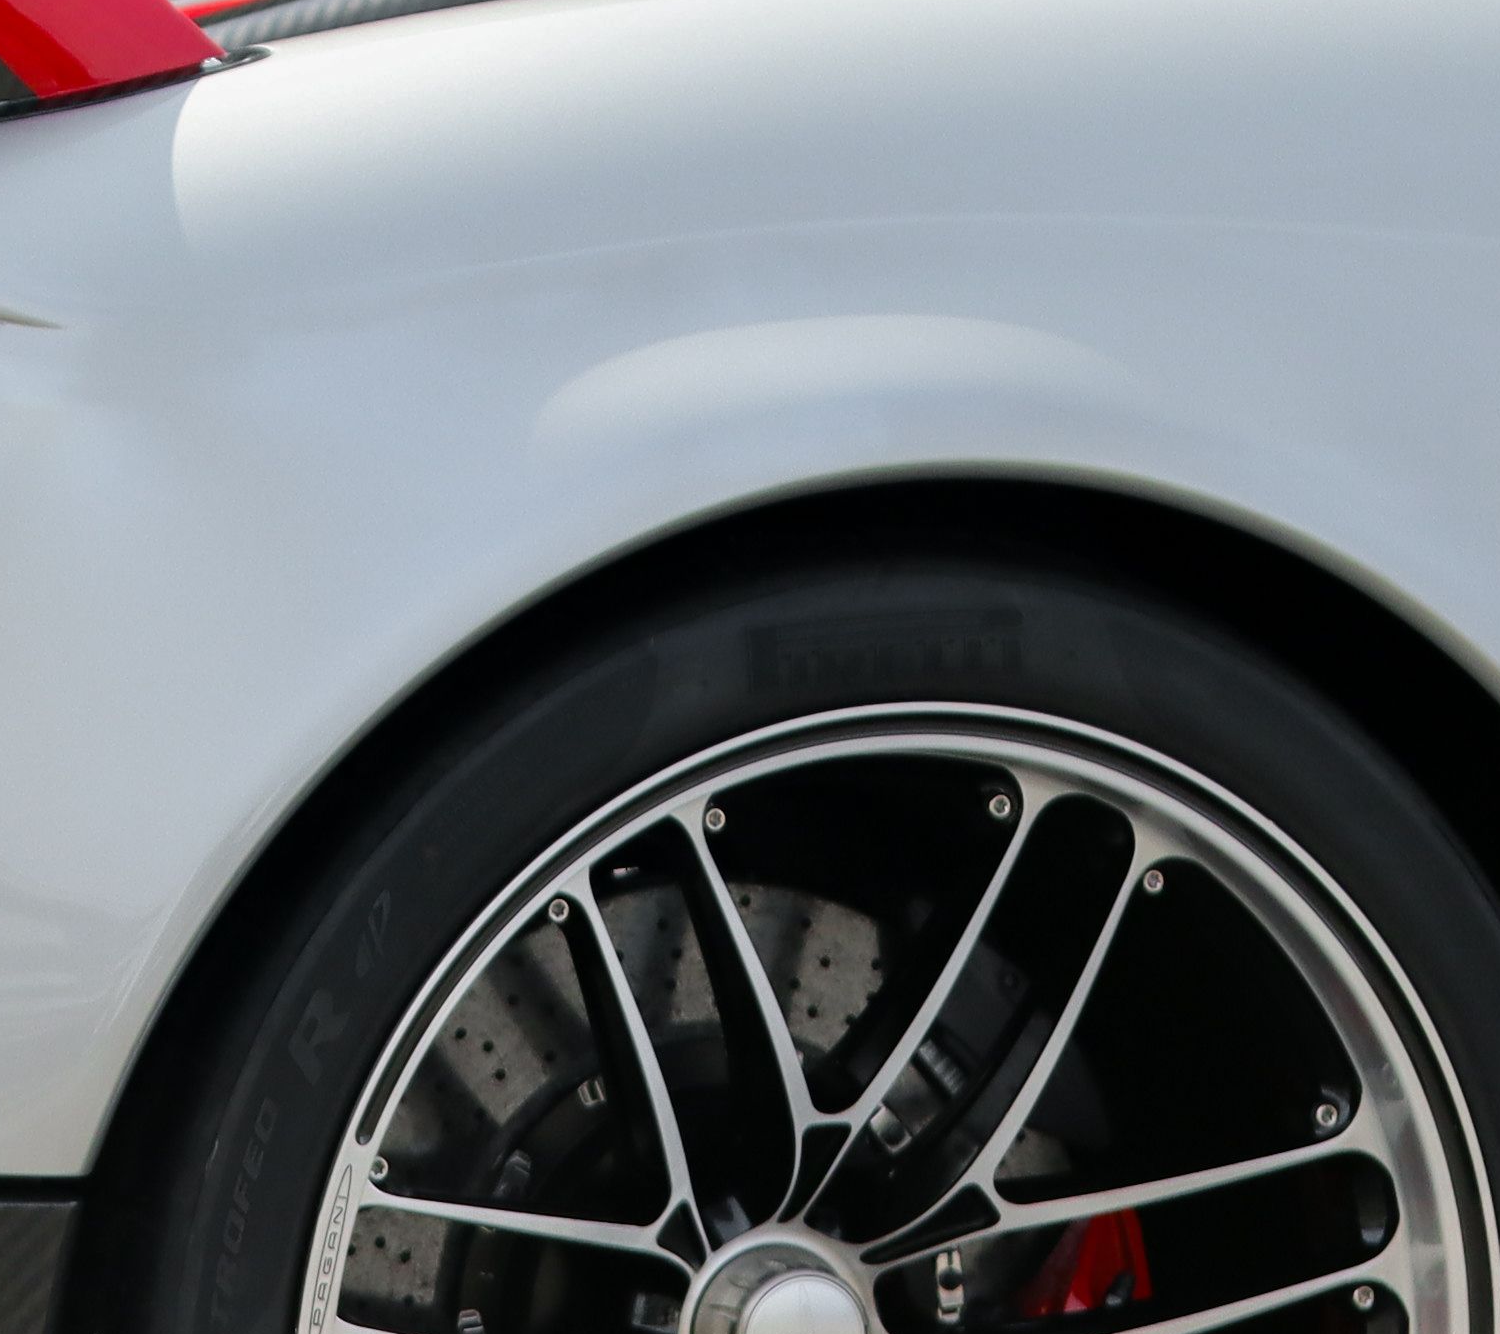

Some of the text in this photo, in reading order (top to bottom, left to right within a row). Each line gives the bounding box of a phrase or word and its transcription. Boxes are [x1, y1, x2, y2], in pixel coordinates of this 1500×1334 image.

[209, 987, 351, 1328] TROFEO R
[311, 1192, 348, 1329] PAGANI
